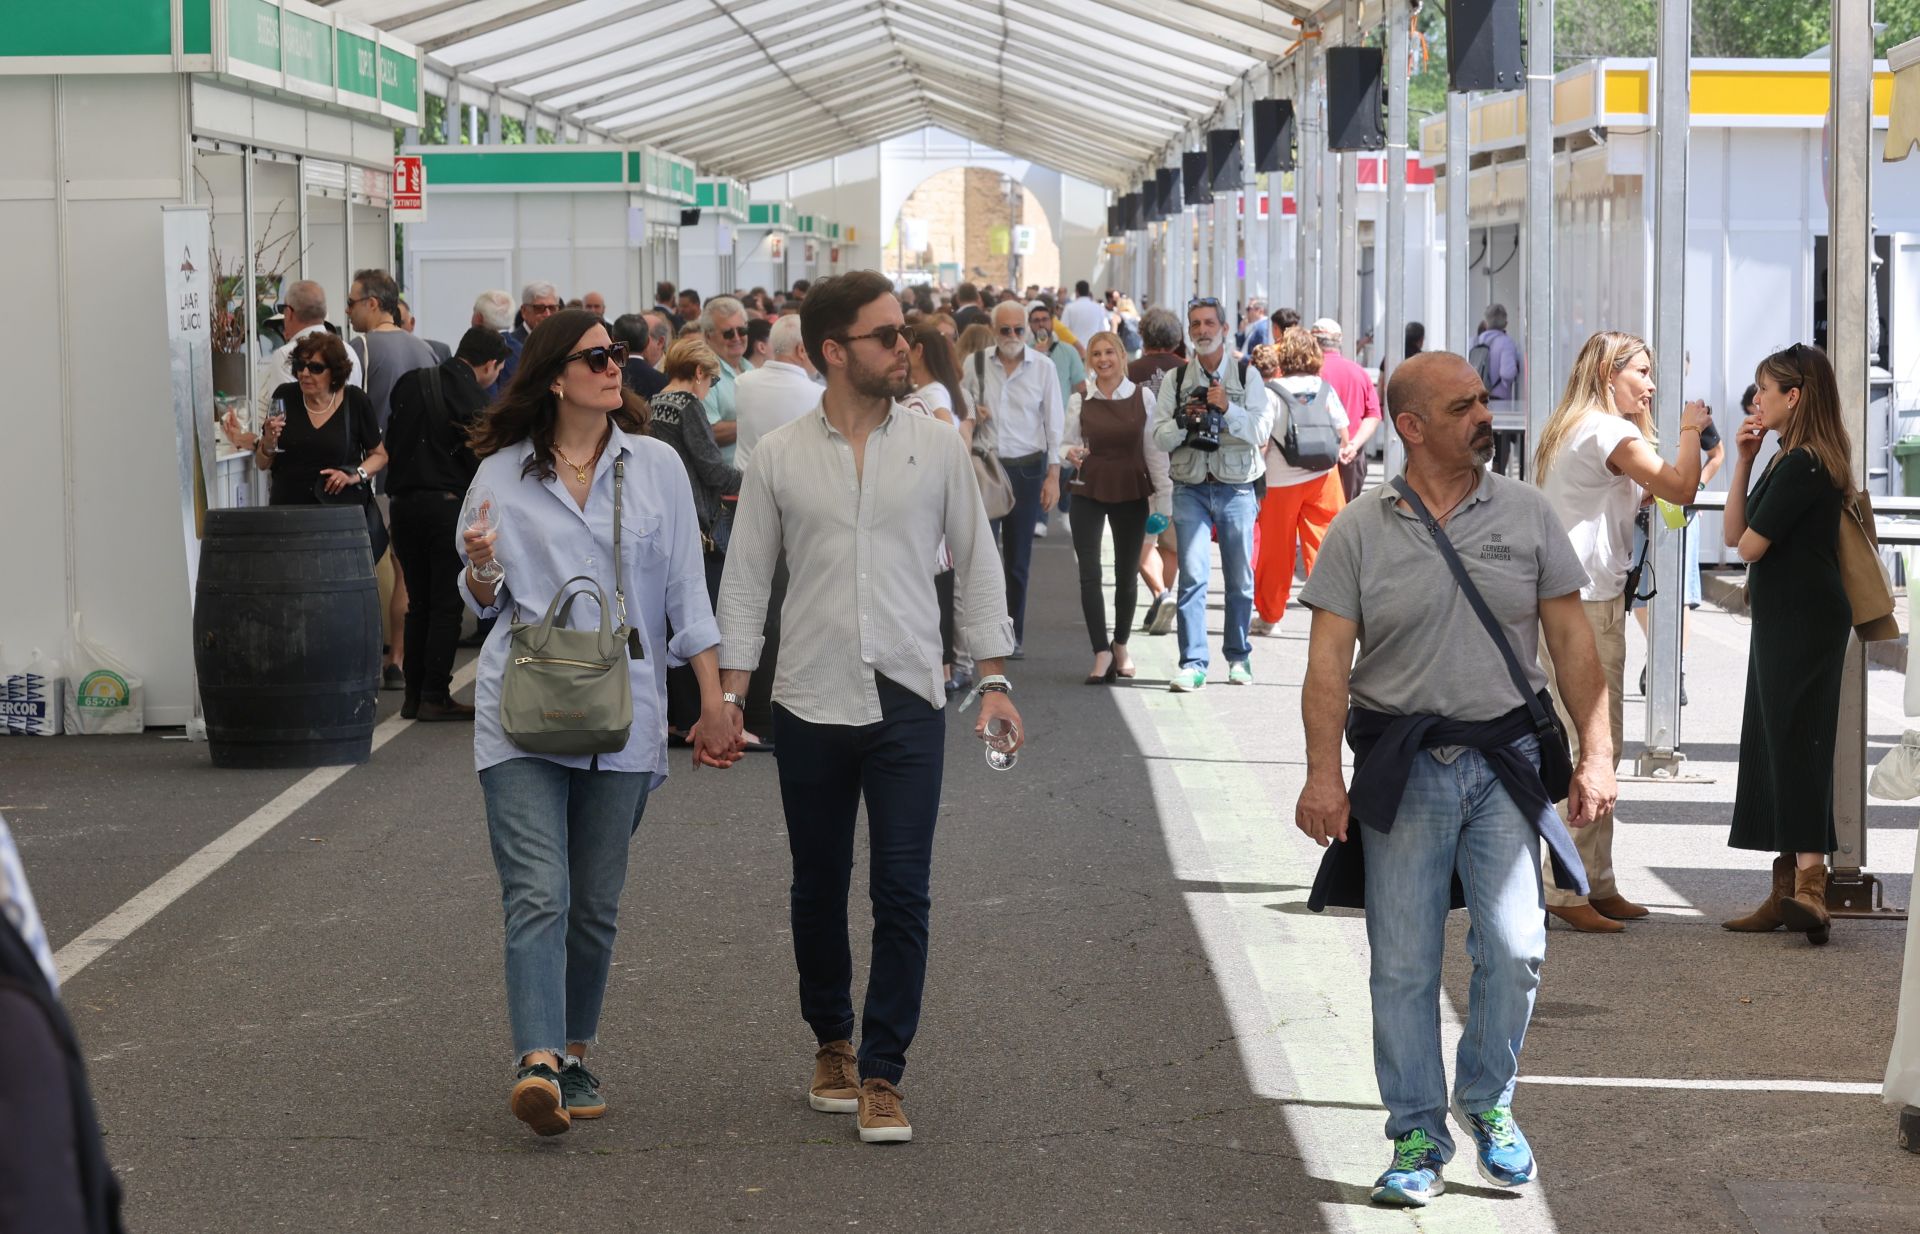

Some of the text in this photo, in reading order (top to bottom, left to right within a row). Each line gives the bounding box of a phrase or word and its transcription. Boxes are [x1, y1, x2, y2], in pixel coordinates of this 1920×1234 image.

[394, 199, 420, 207] EXTINTOR
[1482, 544, 1511, 553] CERVEZAS
[1480, 552, 1512, 561] ALHAMBRA
